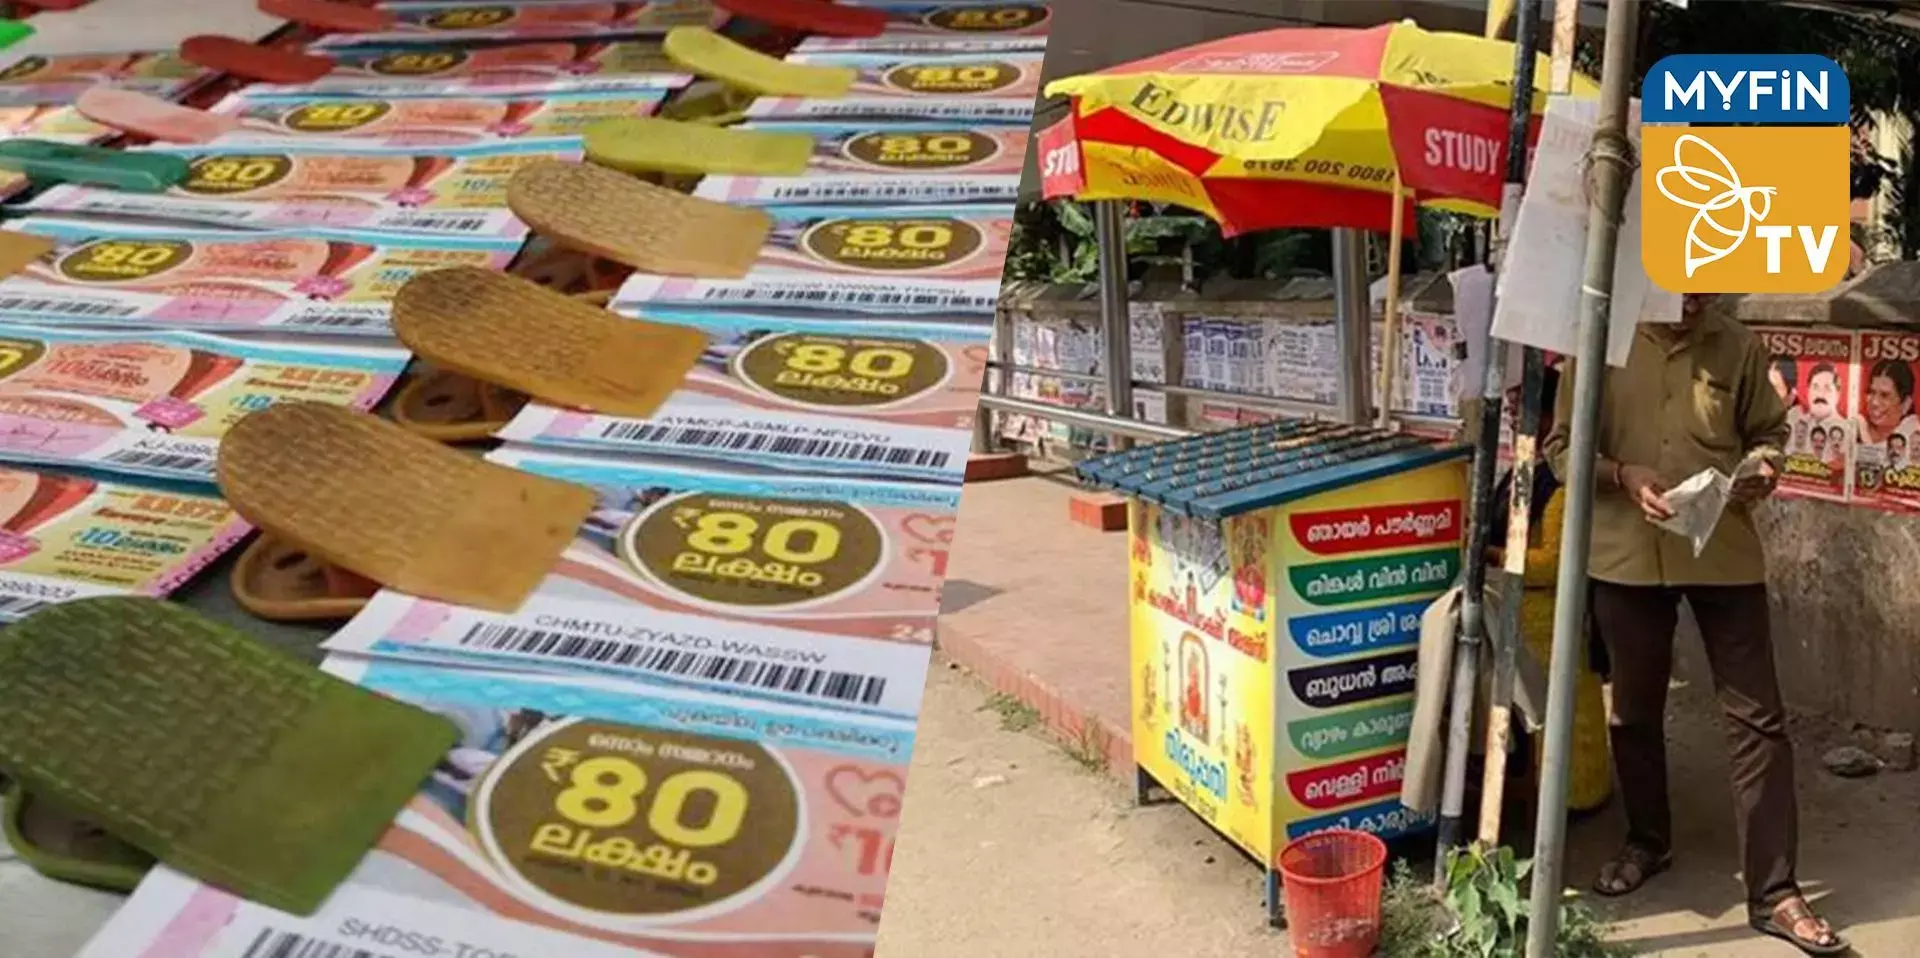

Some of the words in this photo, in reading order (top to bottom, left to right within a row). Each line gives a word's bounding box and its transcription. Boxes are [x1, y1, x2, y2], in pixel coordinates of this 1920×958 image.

[1424, 126, 1501, 175] STUDY
[1864, 336, 1919, 361] JSS
[672, 552, 824, 587] ലക്ഷം
[529, 823, 719, 886] ലക്ഷം
